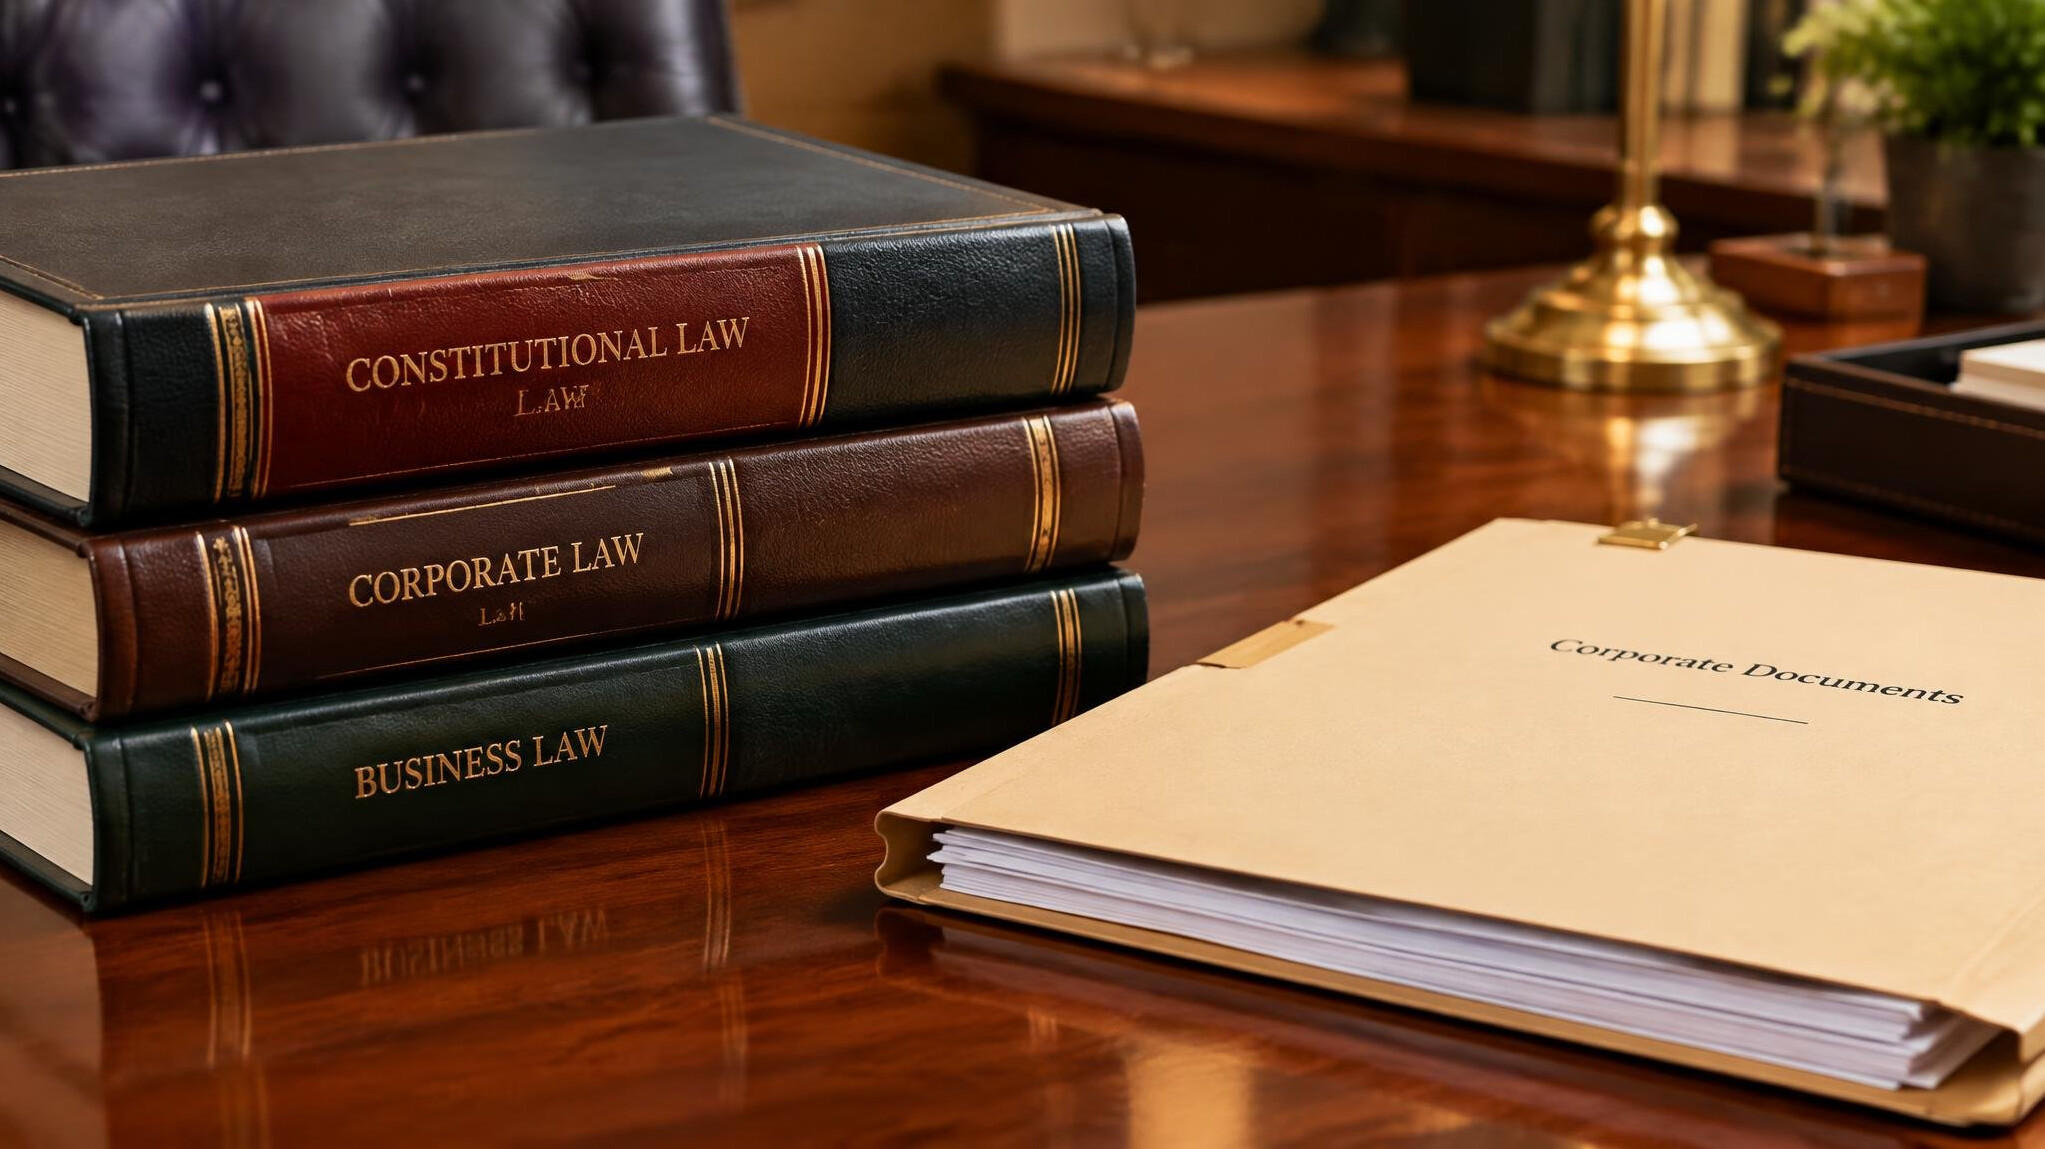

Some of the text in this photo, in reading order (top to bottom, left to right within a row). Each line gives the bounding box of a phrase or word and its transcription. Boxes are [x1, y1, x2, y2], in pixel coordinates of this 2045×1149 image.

[346, 317, 750, 393] CONSTITUTIONAL LAW
[349, 532, 644, 608] CORPORATE LAW
[1549, 638, 1964, 705] Corporate Documents
[354, 725, 608, 799] BUSINESS LAW
